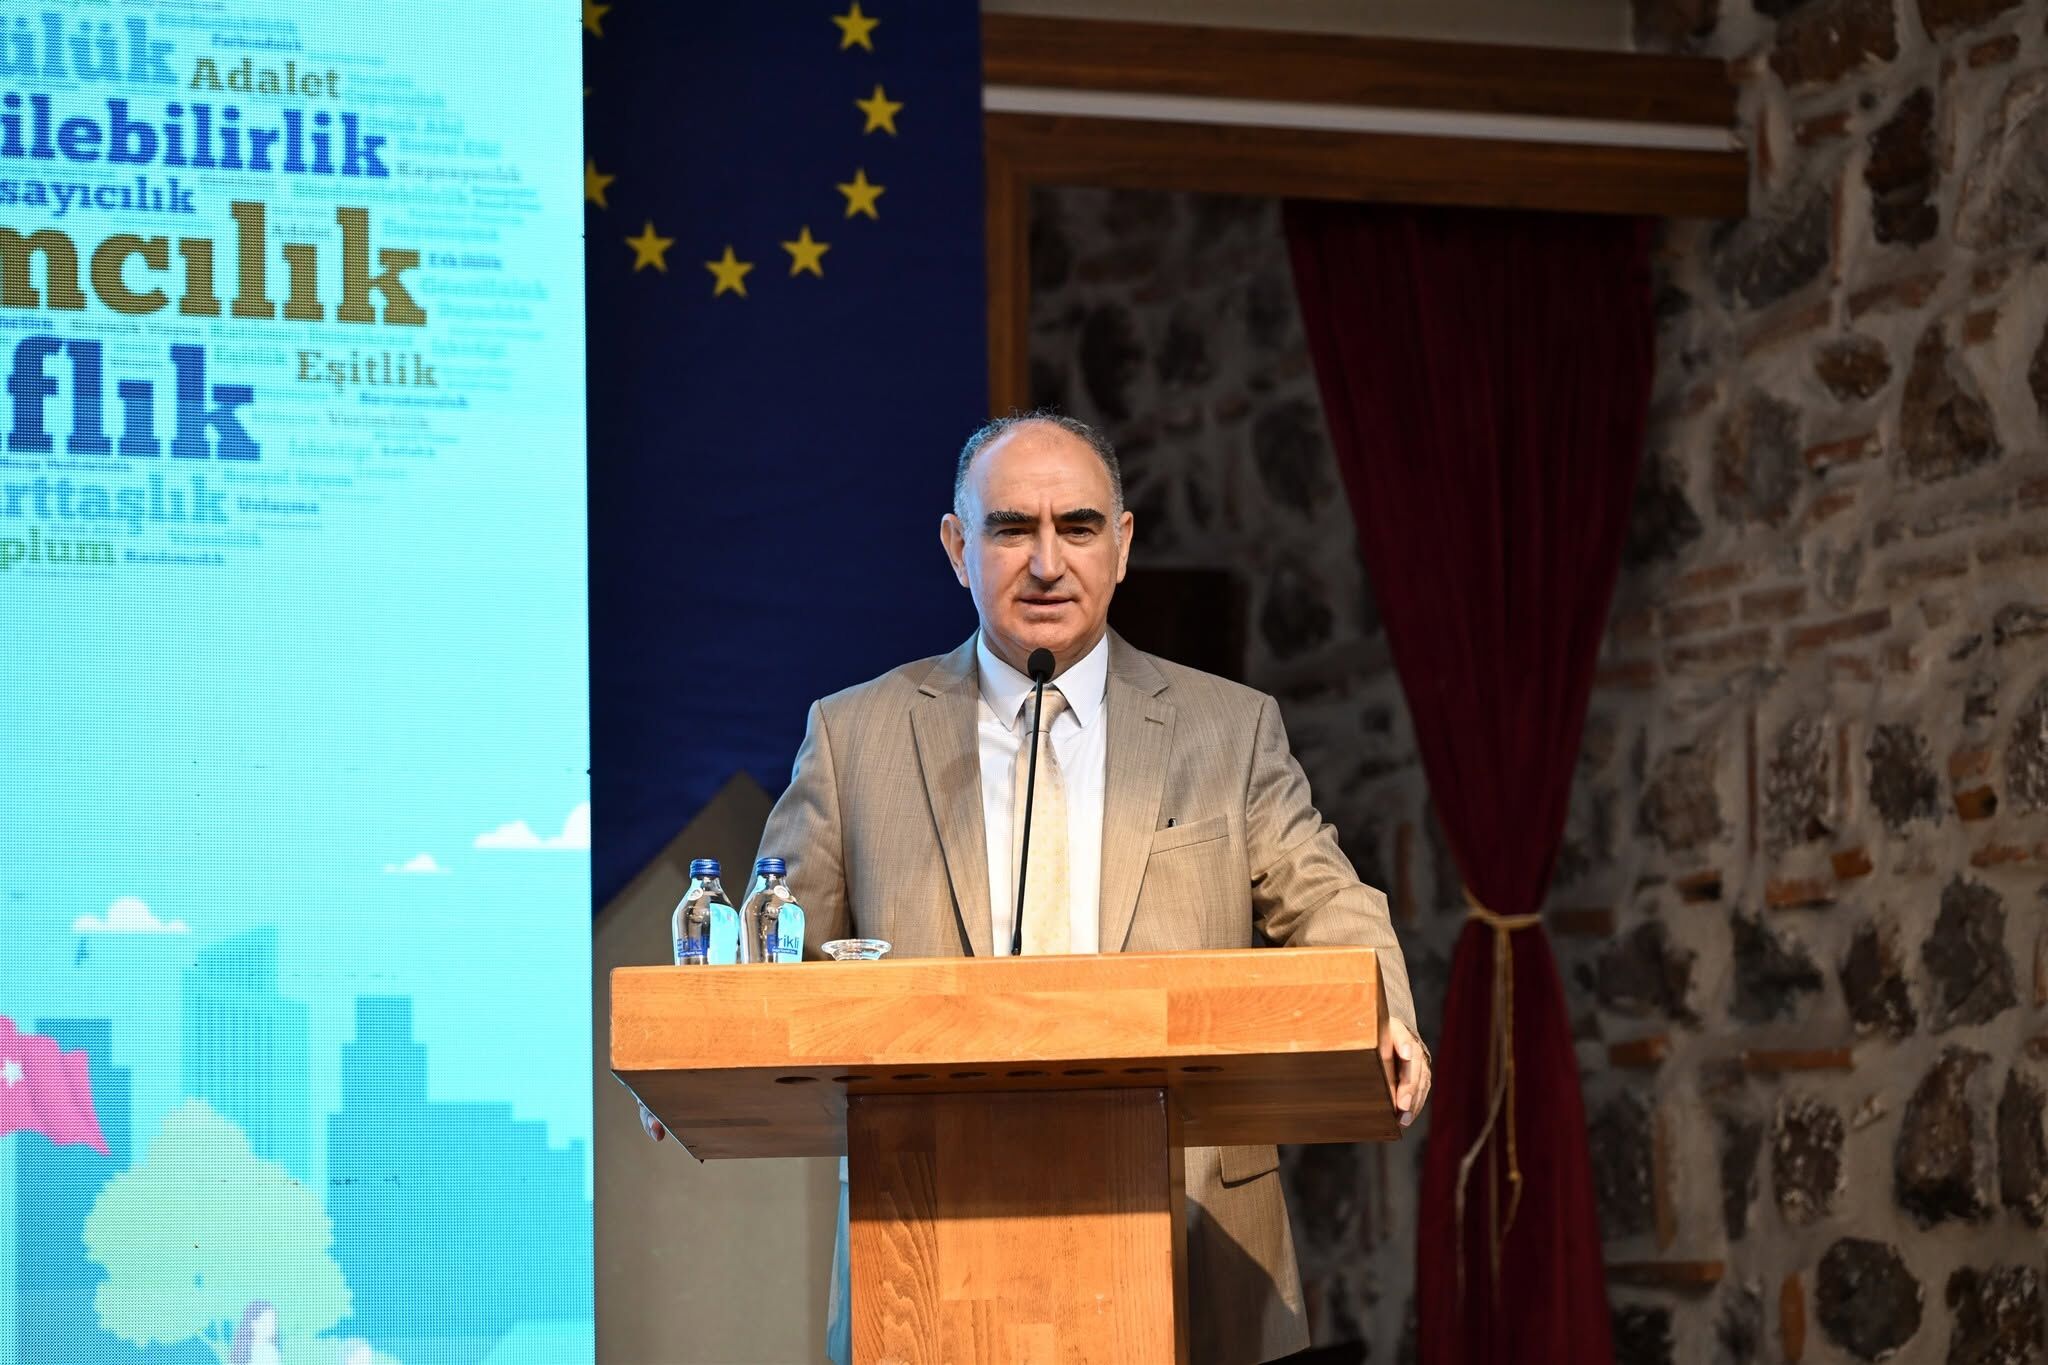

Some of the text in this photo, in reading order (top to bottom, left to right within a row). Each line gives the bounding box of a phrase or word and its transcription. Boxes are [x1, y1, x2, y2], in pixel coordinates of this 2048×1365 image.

[189, 57, 340, 98] Adalet
[0, 92, 389, 178] ilebilirlik
[298, 349, 438, 394] Eşitlik
[0, 527, 115, 570] plum
[767, 934, 800, 950] Erikli
